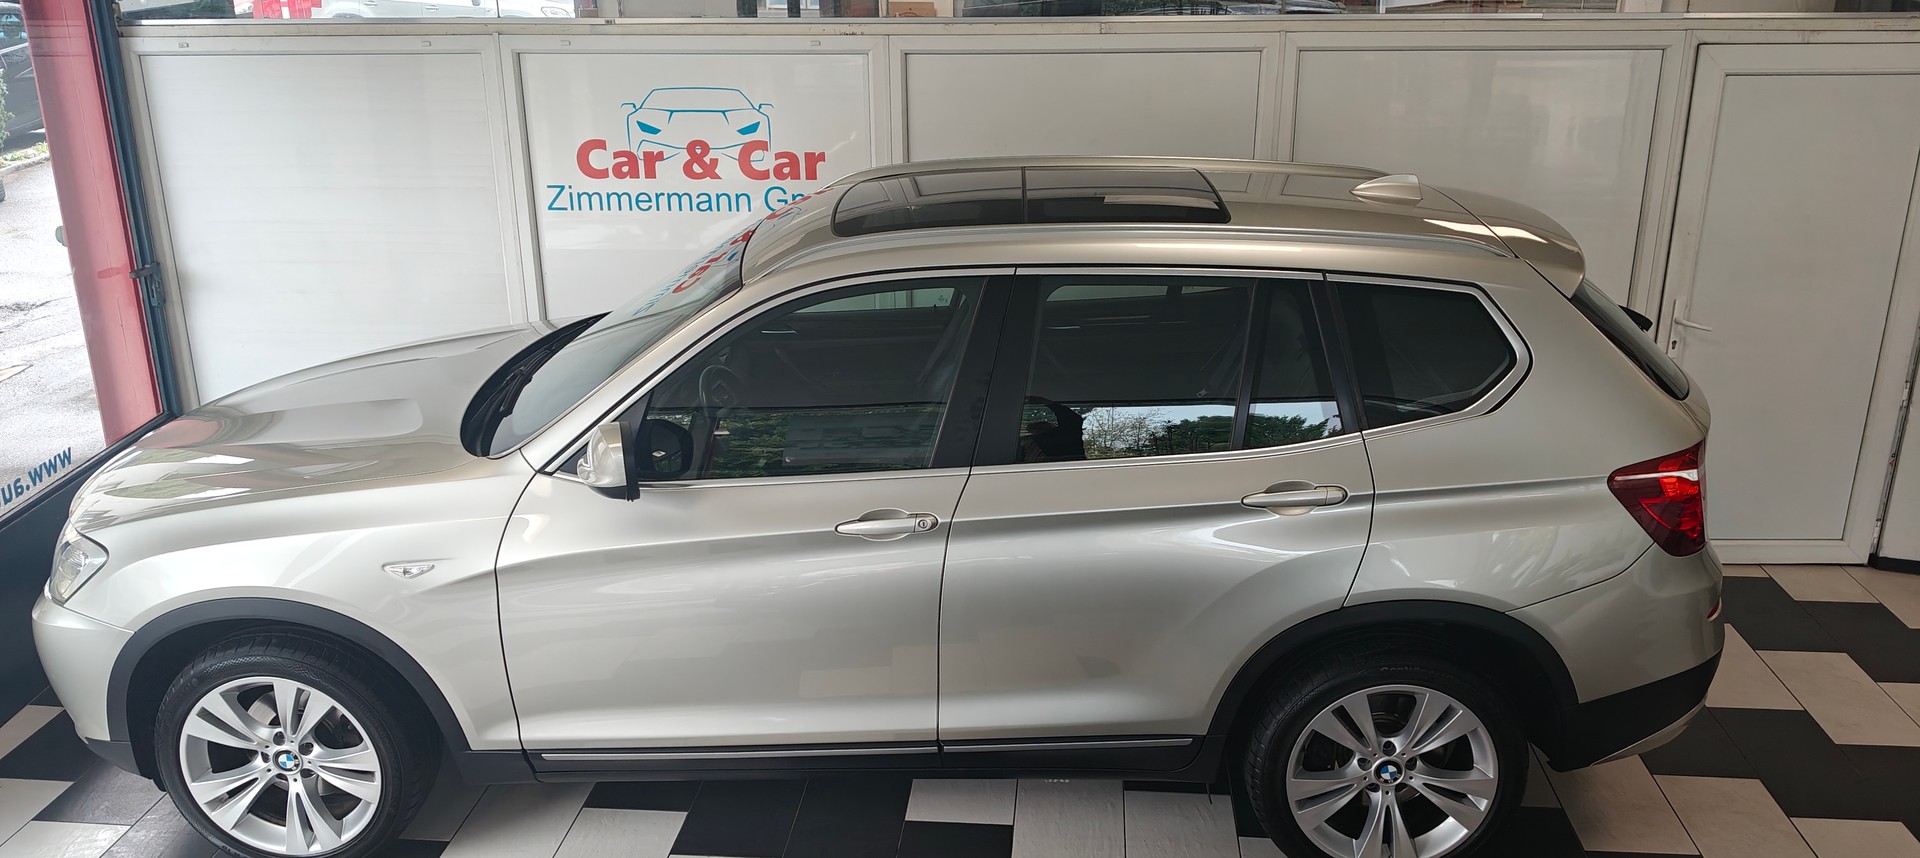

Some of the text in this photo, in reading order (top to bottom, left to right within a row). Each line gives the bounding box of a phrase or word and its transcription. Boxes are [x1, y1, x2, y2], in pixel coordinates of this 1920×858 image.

[576, 138, 826, 181] Car & Car
[546, 184, 752, 213] Zimmermann
